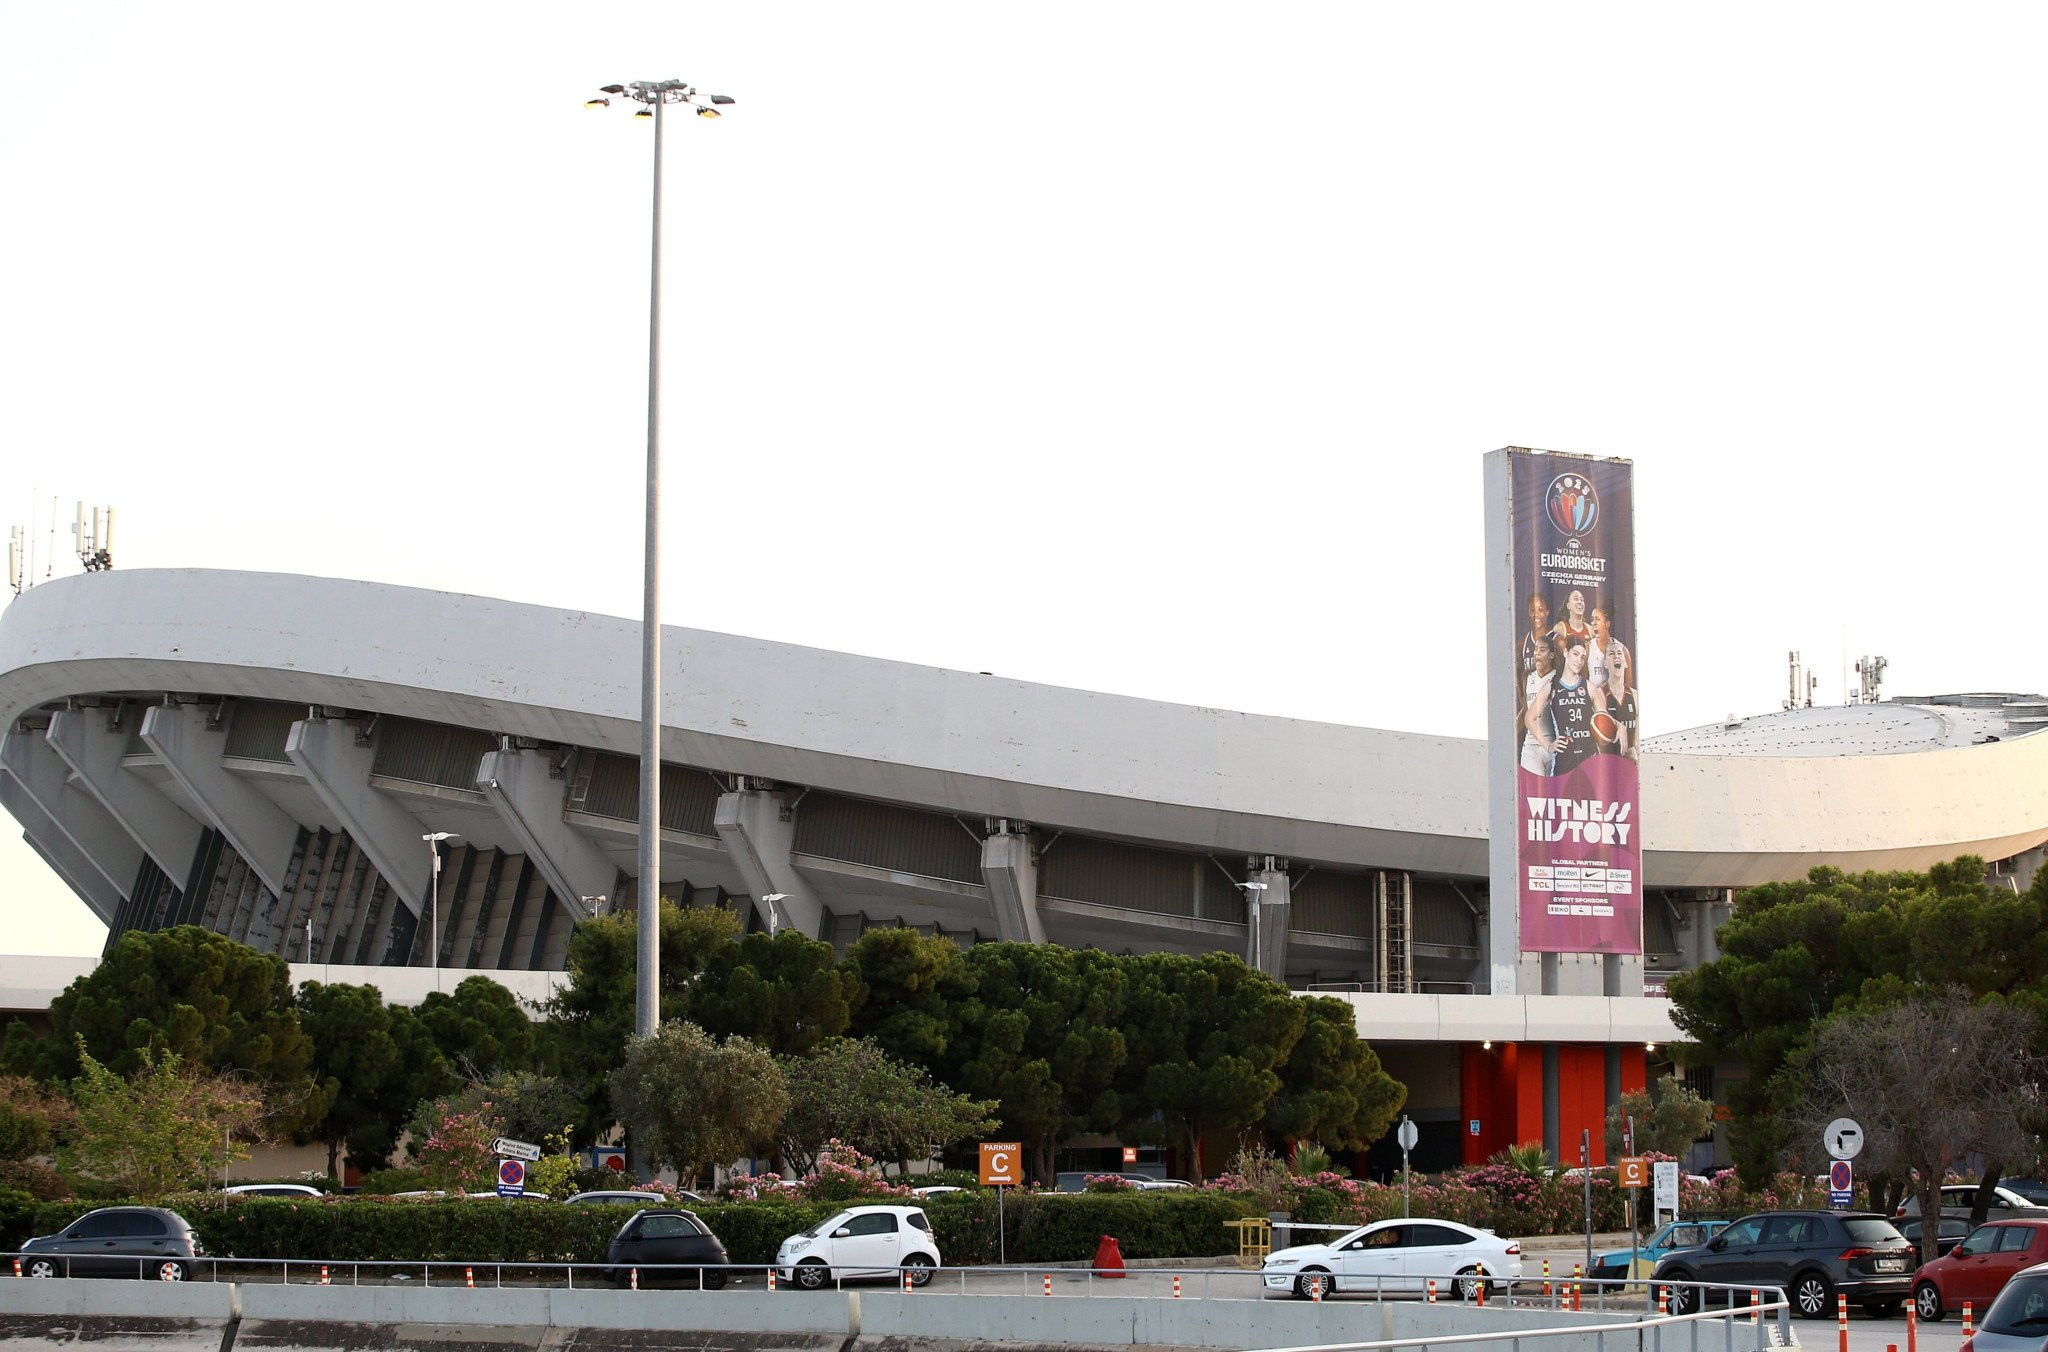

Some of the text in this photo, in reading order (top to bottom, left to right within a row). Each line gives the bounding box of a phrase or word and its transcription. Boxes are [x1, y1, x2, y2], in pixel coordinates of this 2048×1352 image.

[1555, 477, 1591, 496] 2025
[1556, 547, 1592, 557] WOMEN'S
[1540, 553, 1606, 572] EUROBASKET
[1541, 571, 1607, 582] CZECHIA GERMANY
[1572, 580, 1599, 588] GREECE
[1568, 708, 1583, 722] 34
[1527, 797, 1631, 823] WITNESS
[1527, 819, 1631, 845] HISTORY
[1533, 881, 1550, 889] TCL
[991, 1152, 1009, 1173] C
[1626, 1163, 1639, 1179] C
